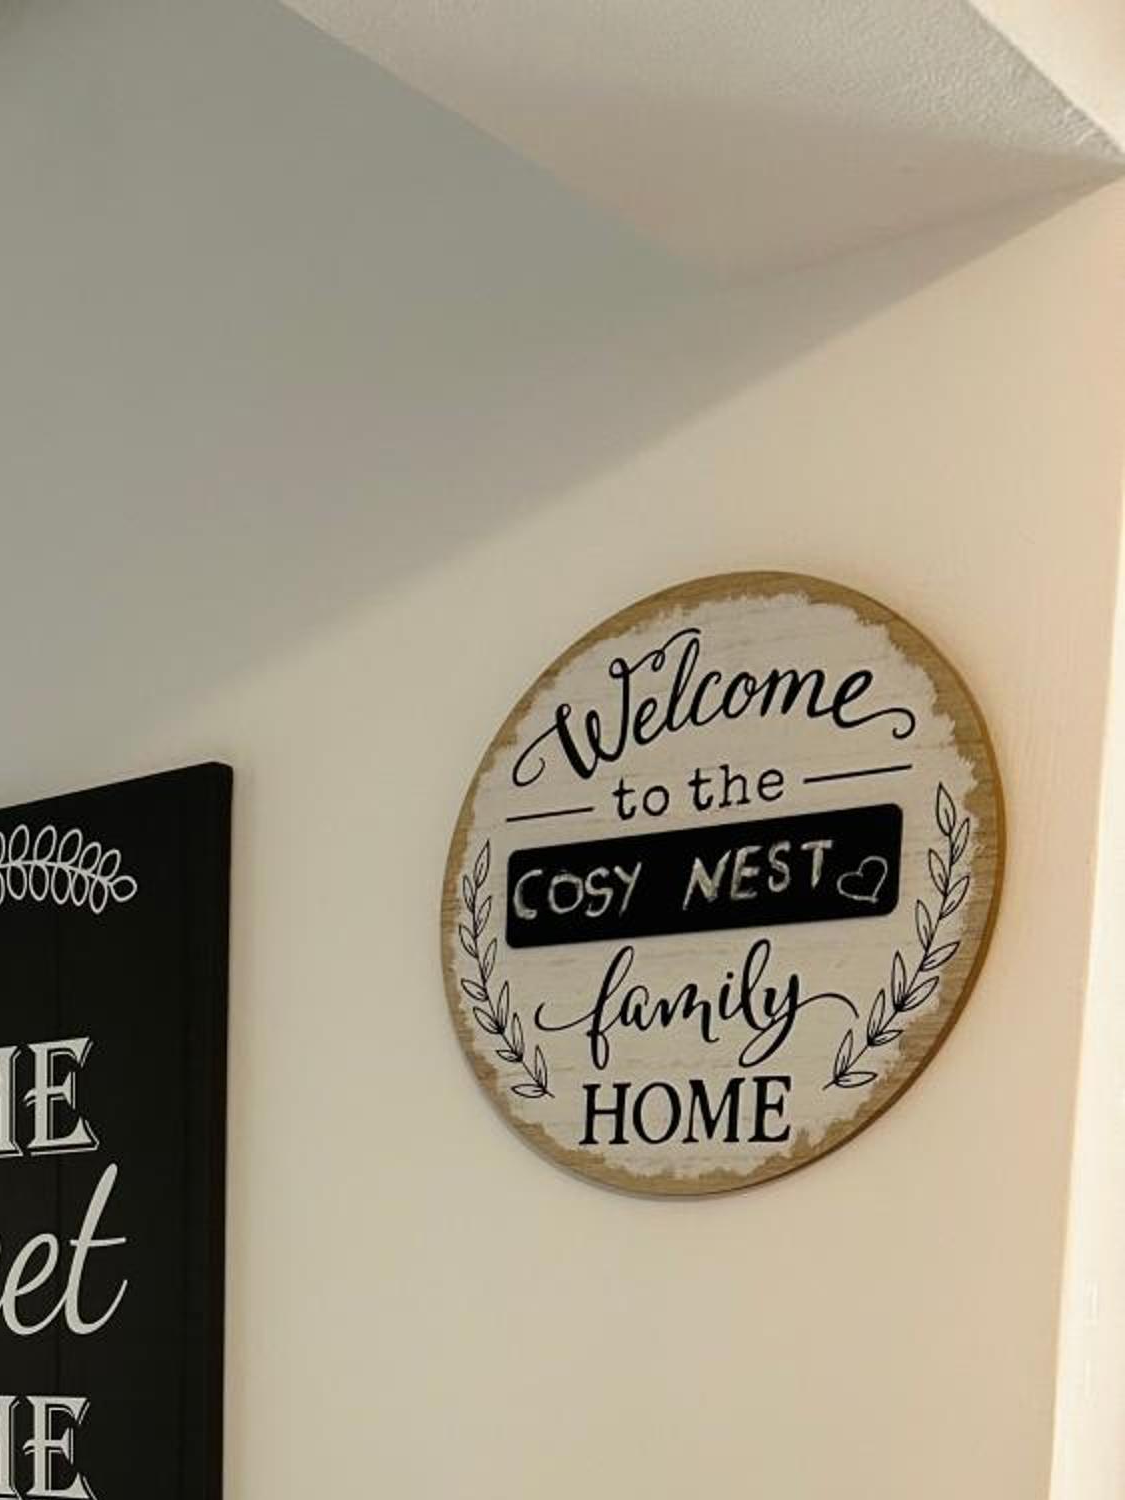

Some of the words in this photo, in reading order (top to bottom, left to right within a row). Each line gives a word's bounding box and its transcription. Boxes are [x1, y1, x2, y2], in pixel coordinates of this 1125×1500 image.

[513, 627, 916, 788] Welcome
[612, 777, 670, 821] to
[687, 763, 786, 810] the
[513, 862, 643, 920] COSY
[683, 839, 834, 911] NEST
[535, 938, 860, 1070] family
[578, 1075, 793, 1146] HOME
